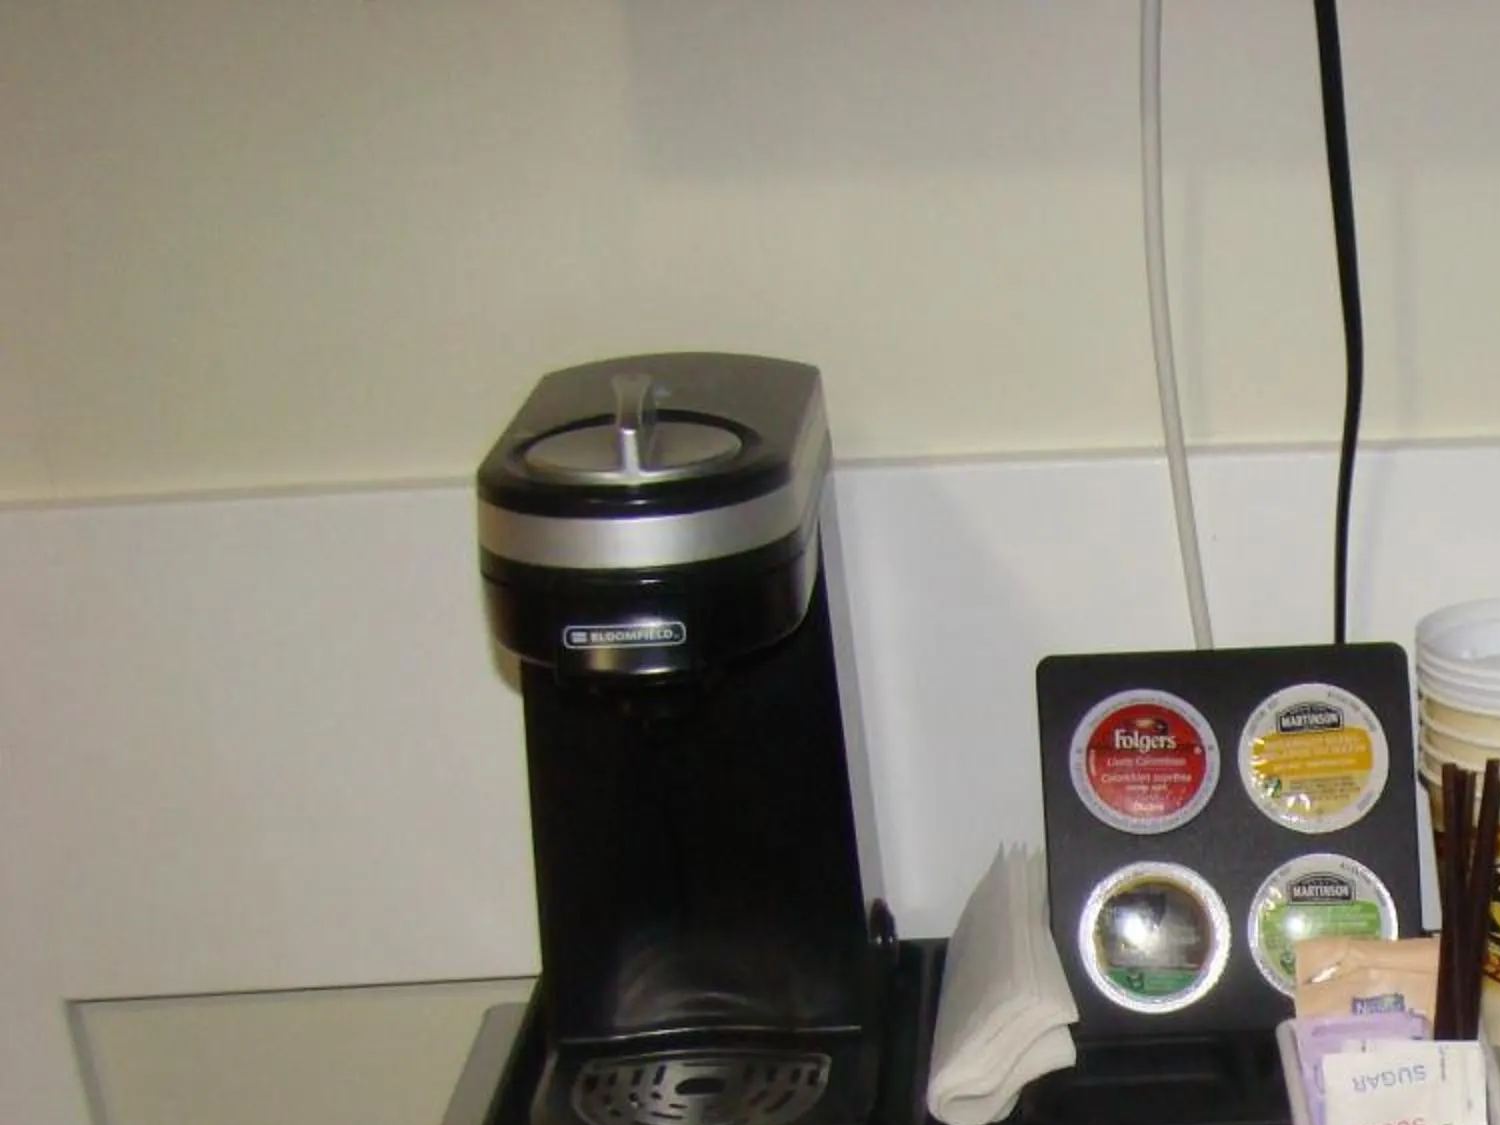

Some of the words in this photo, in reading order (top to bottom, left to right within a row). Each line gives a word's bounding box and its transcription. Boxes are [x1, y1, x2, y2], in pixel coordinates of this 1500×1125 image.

[590, 628, 673, 643] BLOOMFIELD
[1281, 713, 1339, 729] MARTINSON
[1114, 728, 1177, 752] Folgers
[1292, 884, 1350, 897] MARTINSON
[1352, 1064, 1427, 1092] SUGAR
